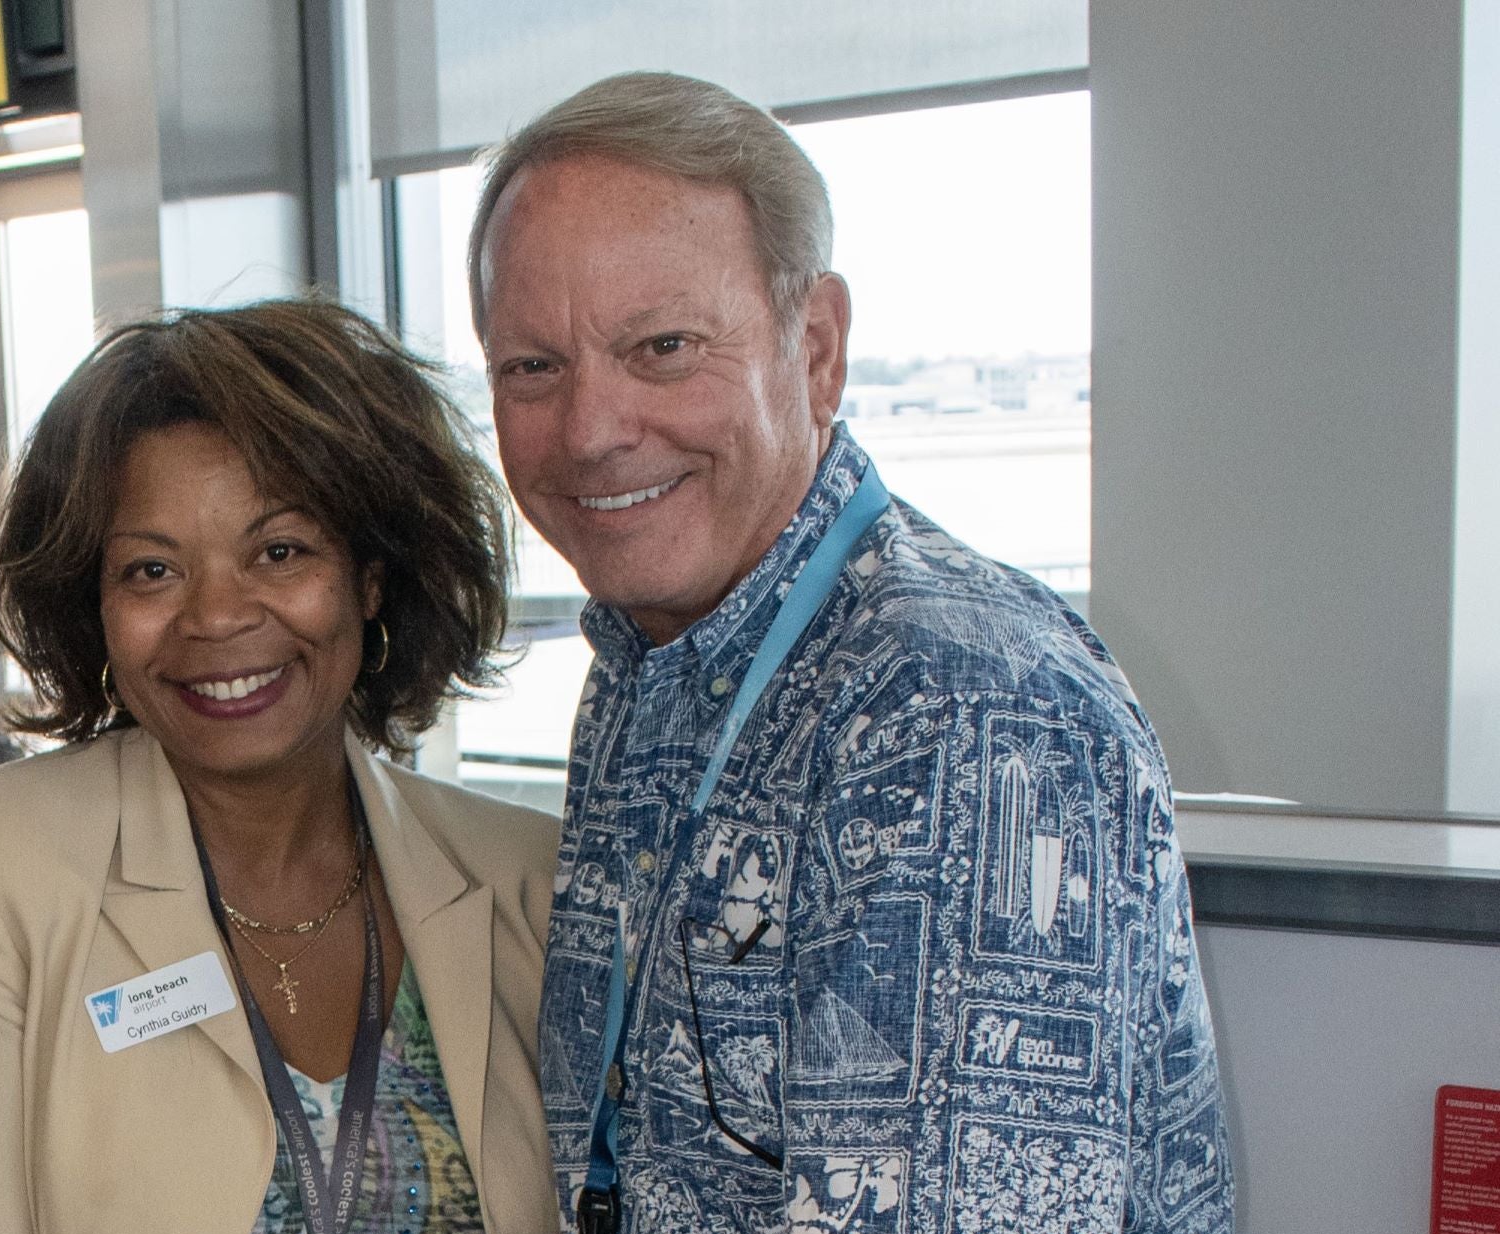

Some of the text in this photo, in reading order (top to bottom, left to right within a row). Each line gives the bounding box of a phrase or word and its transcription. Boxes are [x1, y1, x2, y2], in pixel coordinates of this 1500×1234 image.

[128, 974, 189, 1005] long beach
[132, 995, 168, 1015] airport
[126, 1002, 209, 1039] Cynthia Guidry
[1017, 1051, 1083, 1071] spooner
[1018, 1037, 1054, 1055] reyn
[284, 1108, 306, 1150] airport
[297, 1152, 319, 1206] coolest
[334, 1110, 365, 1225] america's coolest
